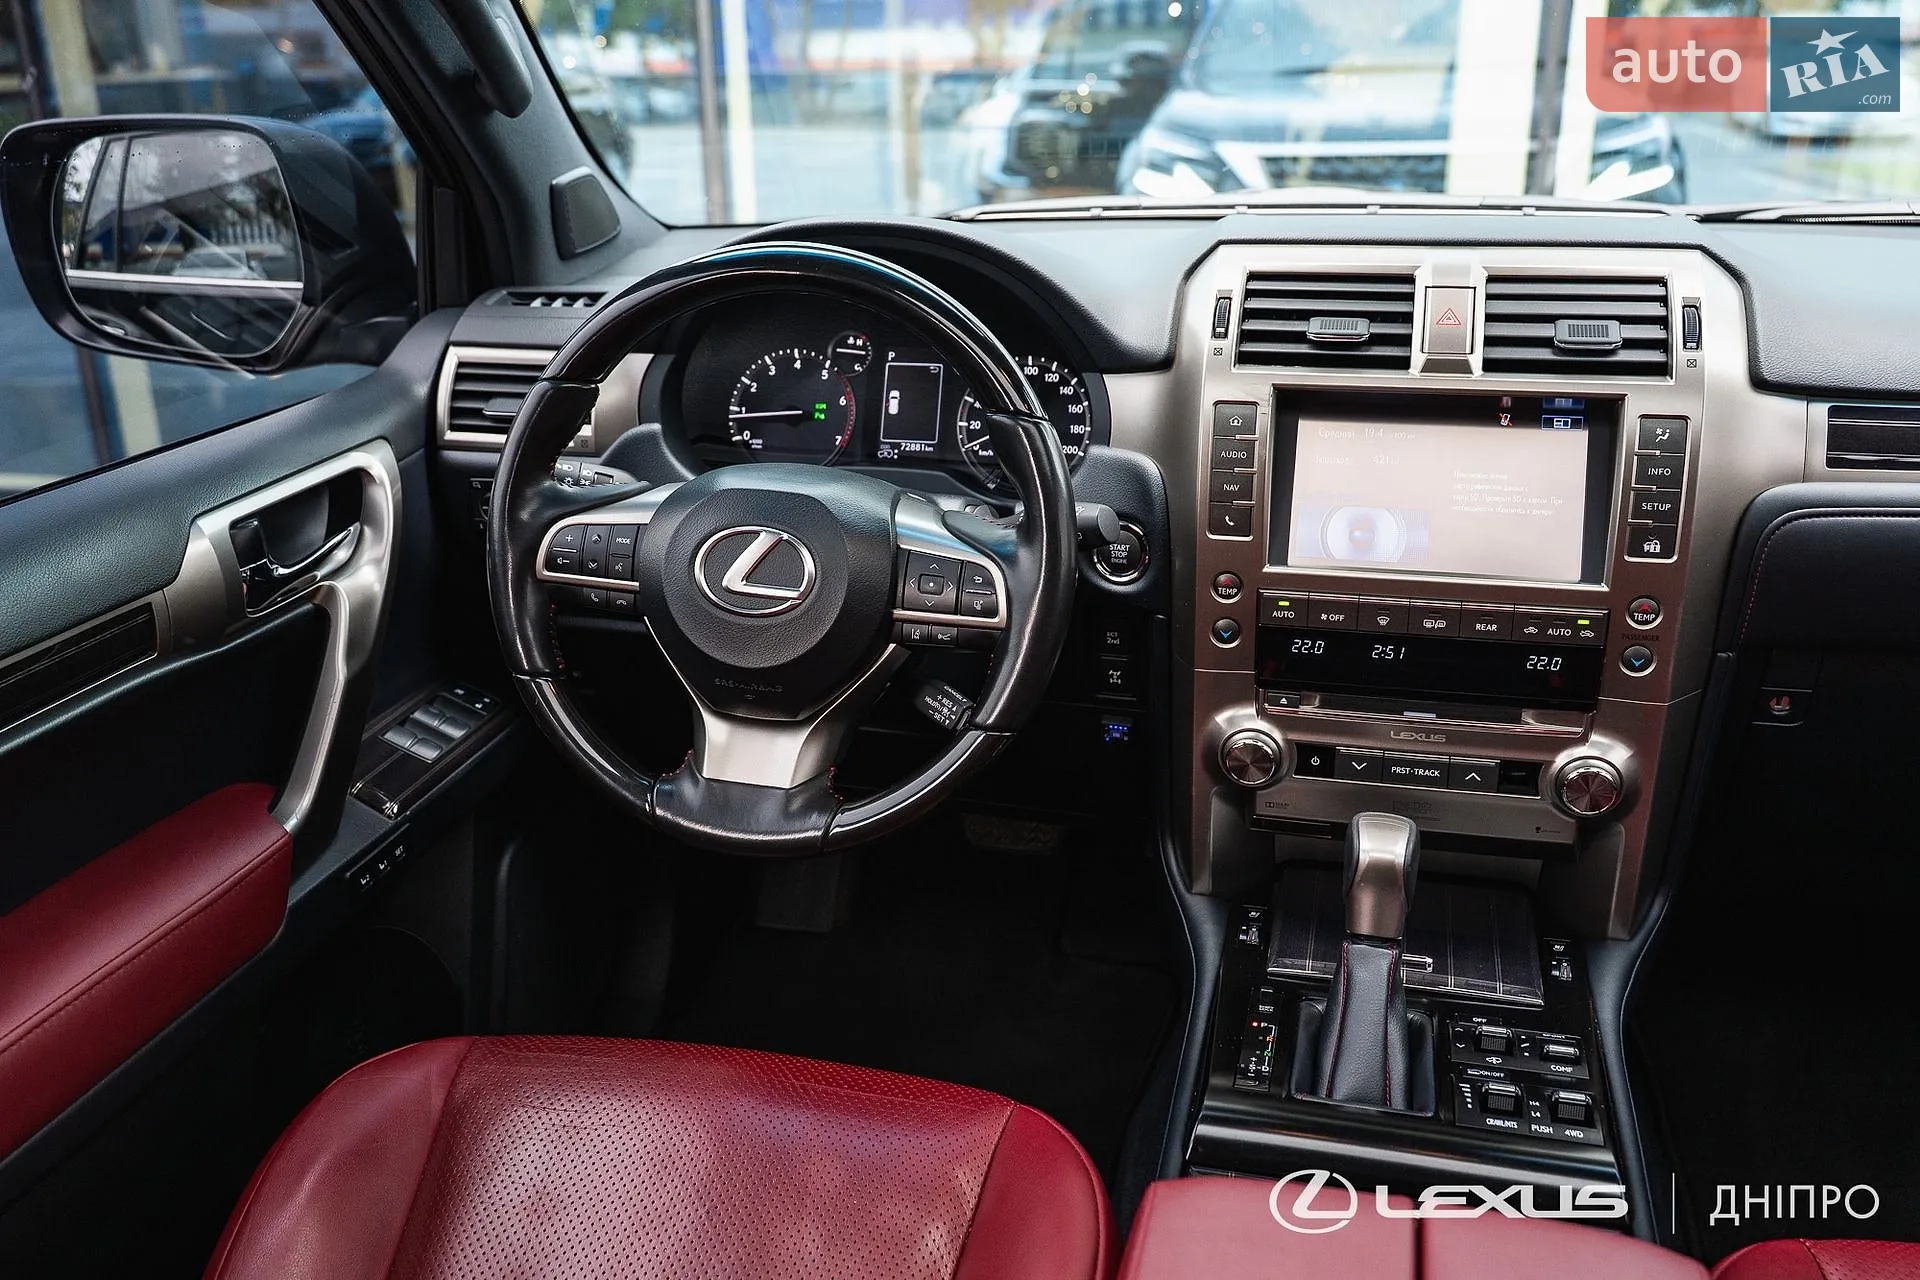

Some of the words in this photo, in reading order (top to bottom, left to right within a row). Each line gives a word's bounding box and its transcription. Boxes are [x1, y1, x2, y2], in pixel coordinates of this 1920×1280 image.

[888, 351, 896, 361] P
[793, 360, 801, 370] 4
[768, 365, 776, 376] 3
[821, 369, 829, 380] 5
[1023, 366, 1039, 376] 100
[1044, 373, 1060, 383] 120
[750, 382, 757, 393] 2
[1059, 386, 1074, 395] 140
[839, 395, 847, 406] 6
[1068, 404, 1084, 414] 160
[969, 420, 981, 429] 20
[1070, 425, 1085, 434] 180
[743, 430, 750, 441] 0
[835, 435, 842, 446] 7
[1062, 445, 1079, 455] 200
[1220, 450, 1247, 459] AUDIO
[1648, 467, 1672, 476] INFO
[1223, 483, 1240, 492] NAV
[1641, 502, 1672, 511] SETUP
[615, 537, 631, 545] MODE
[1109, 543, 1131, 552] START
[1110, 550, 1128, 559] STOP
[1217, 587, 1238, 596] TEMP
[1272, 610, 1295, 619] AUTO
[1328, 613, 1345, 622] OFF
[1633, 613, 1656, 622] TEMP
[1475, 623, 1498, 632] REAR
[1546, 628, 1572, 637] AUTO
[1291, 639, 1325, 655] 22.0
[1371, 645, 1406, 660] 2:51
[1526, 655, 1562, 671] 22.0
[1390, 730, 1446, 743] LEXUS
[1550, 1064, 1573, 1073] COMP
[1531, 1123, 1553, 1135] PUSH
[1564, 1129, 1584, 1139] 4WD
